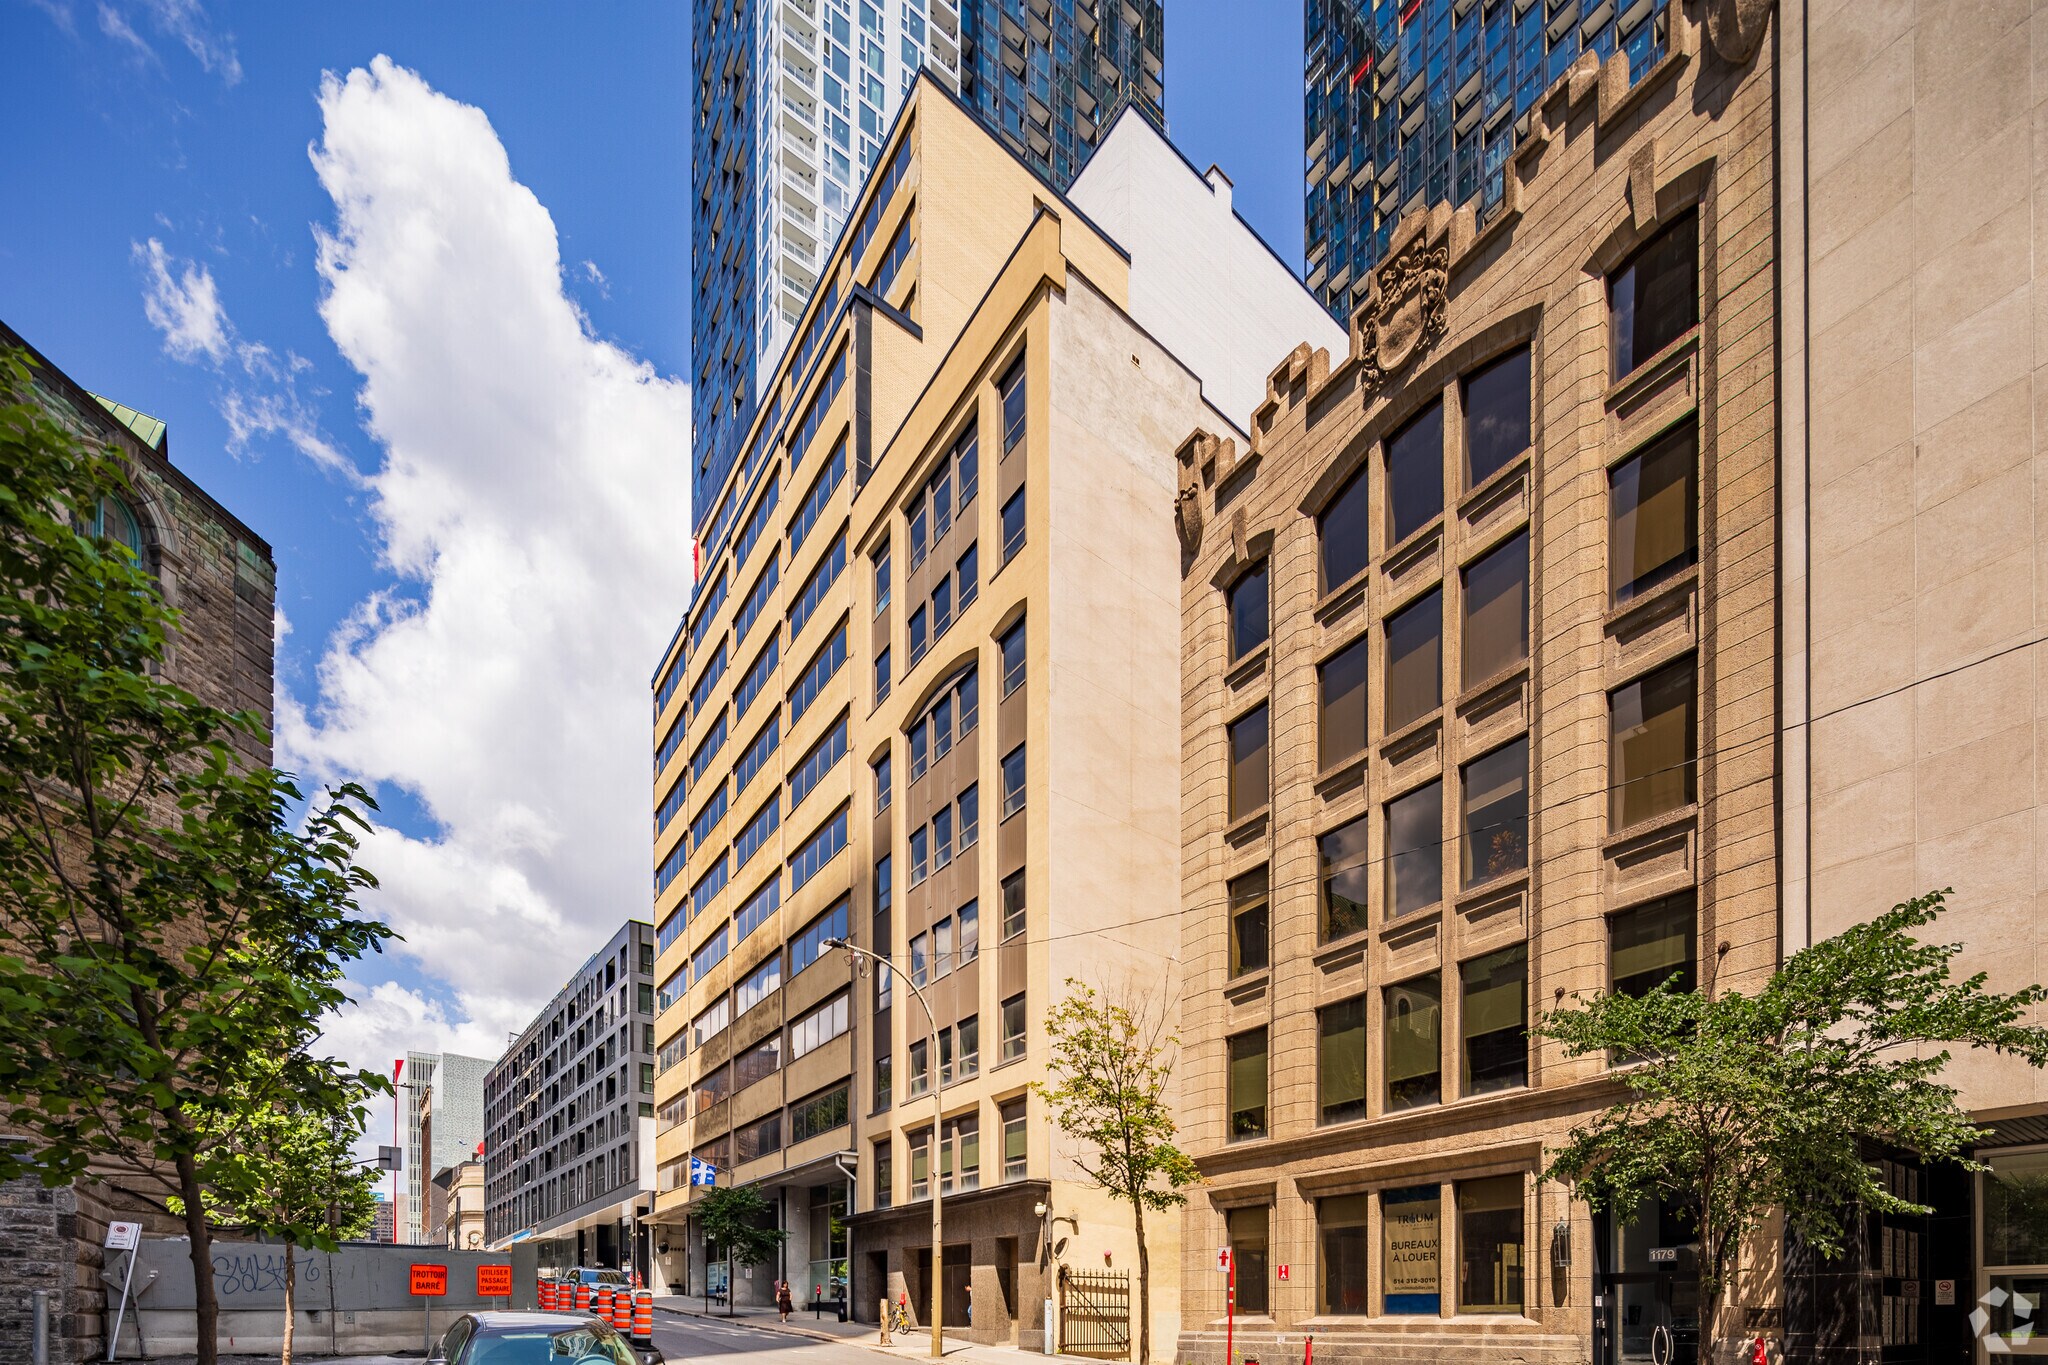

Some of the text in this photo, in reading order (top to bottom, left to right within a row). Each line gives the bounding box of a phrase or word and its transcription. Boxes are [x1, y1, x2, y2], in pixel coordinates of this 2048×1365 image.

[1391, 1239, 1438, 1250] BUREAUX
[1393, 1252, 1436, 1262] À LOUER
[1650, 1249, 1675, 1259] 1179
[412, 1270, 445, 1278] TROTTOIR
[416, 1281, 440, 1290] BARRÉ
